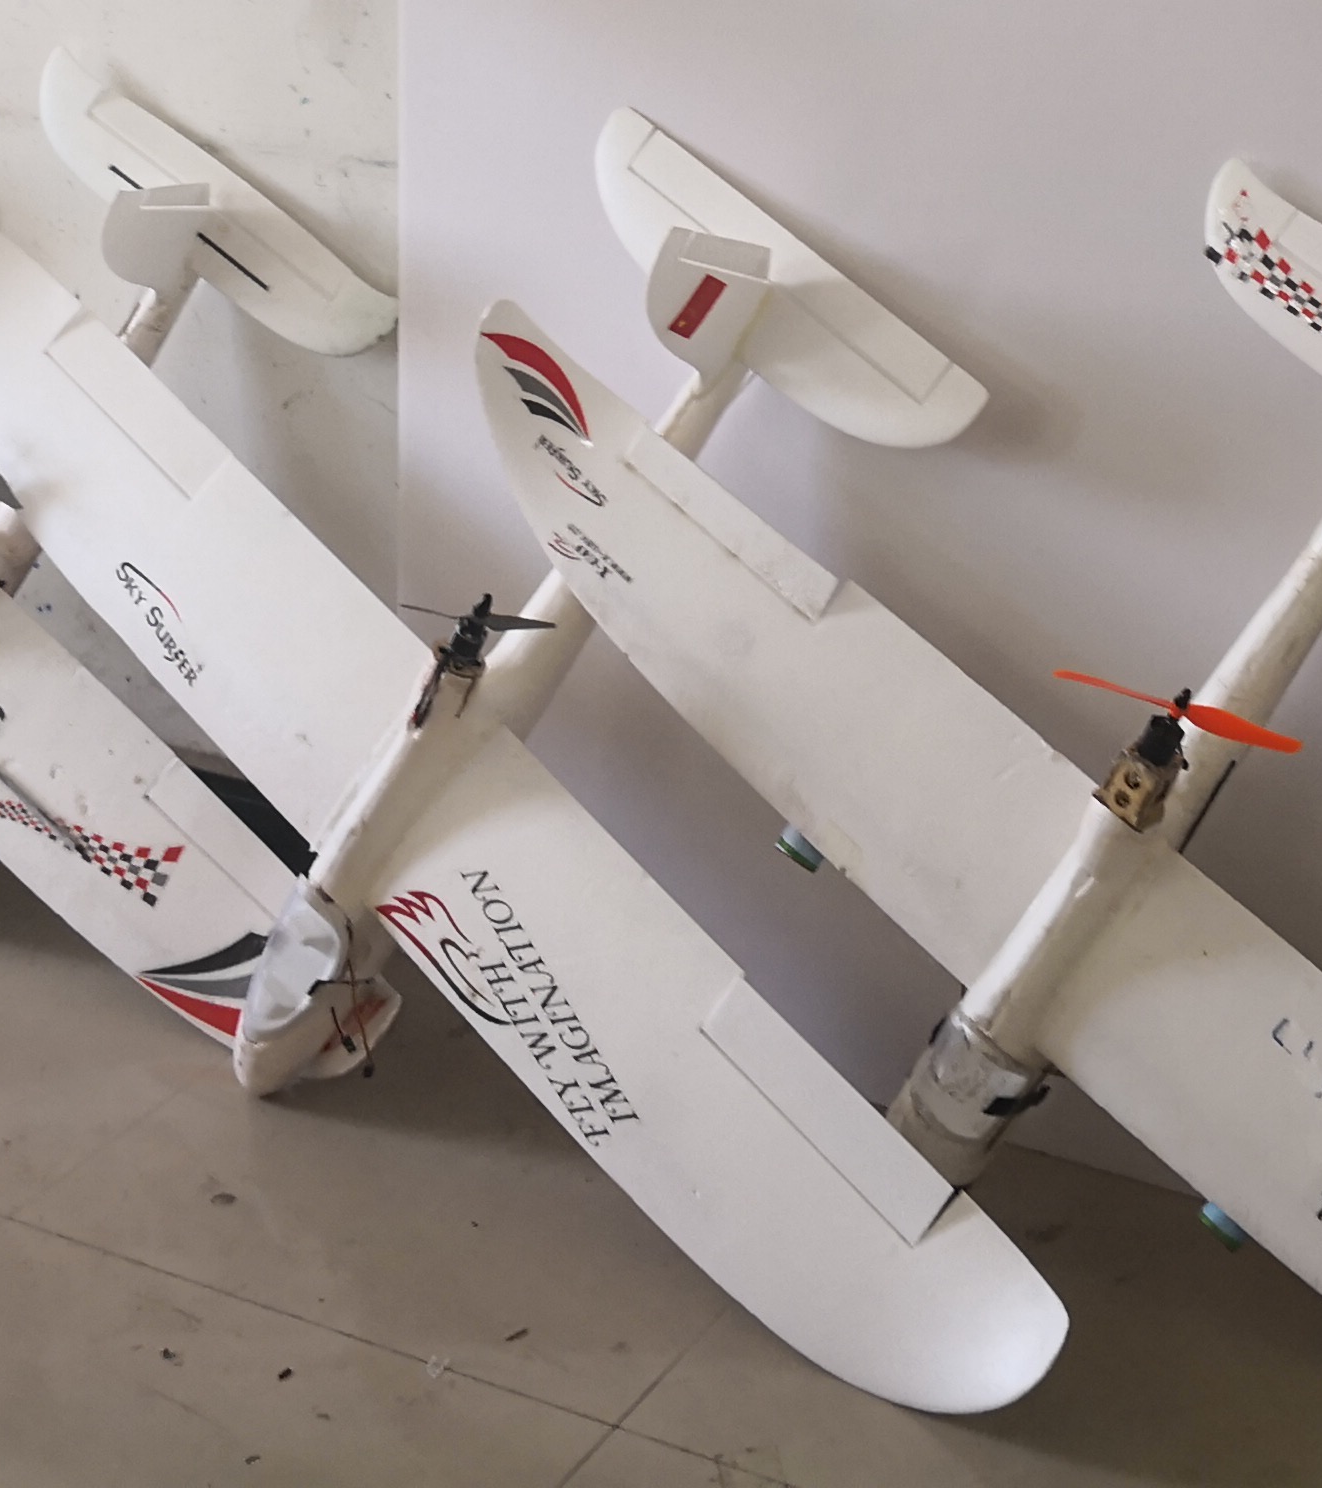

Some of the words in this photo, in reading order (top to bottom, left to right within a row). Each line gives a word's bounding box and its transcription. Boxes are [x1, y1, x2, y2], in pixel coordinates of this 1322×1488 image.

[115, 561, 148, 606] SKY
[460, 868, 641, 1124] IMAGINATION
[479, 961, 557, 1071] WITH
[548, 1075, 611, 1148] FLY
